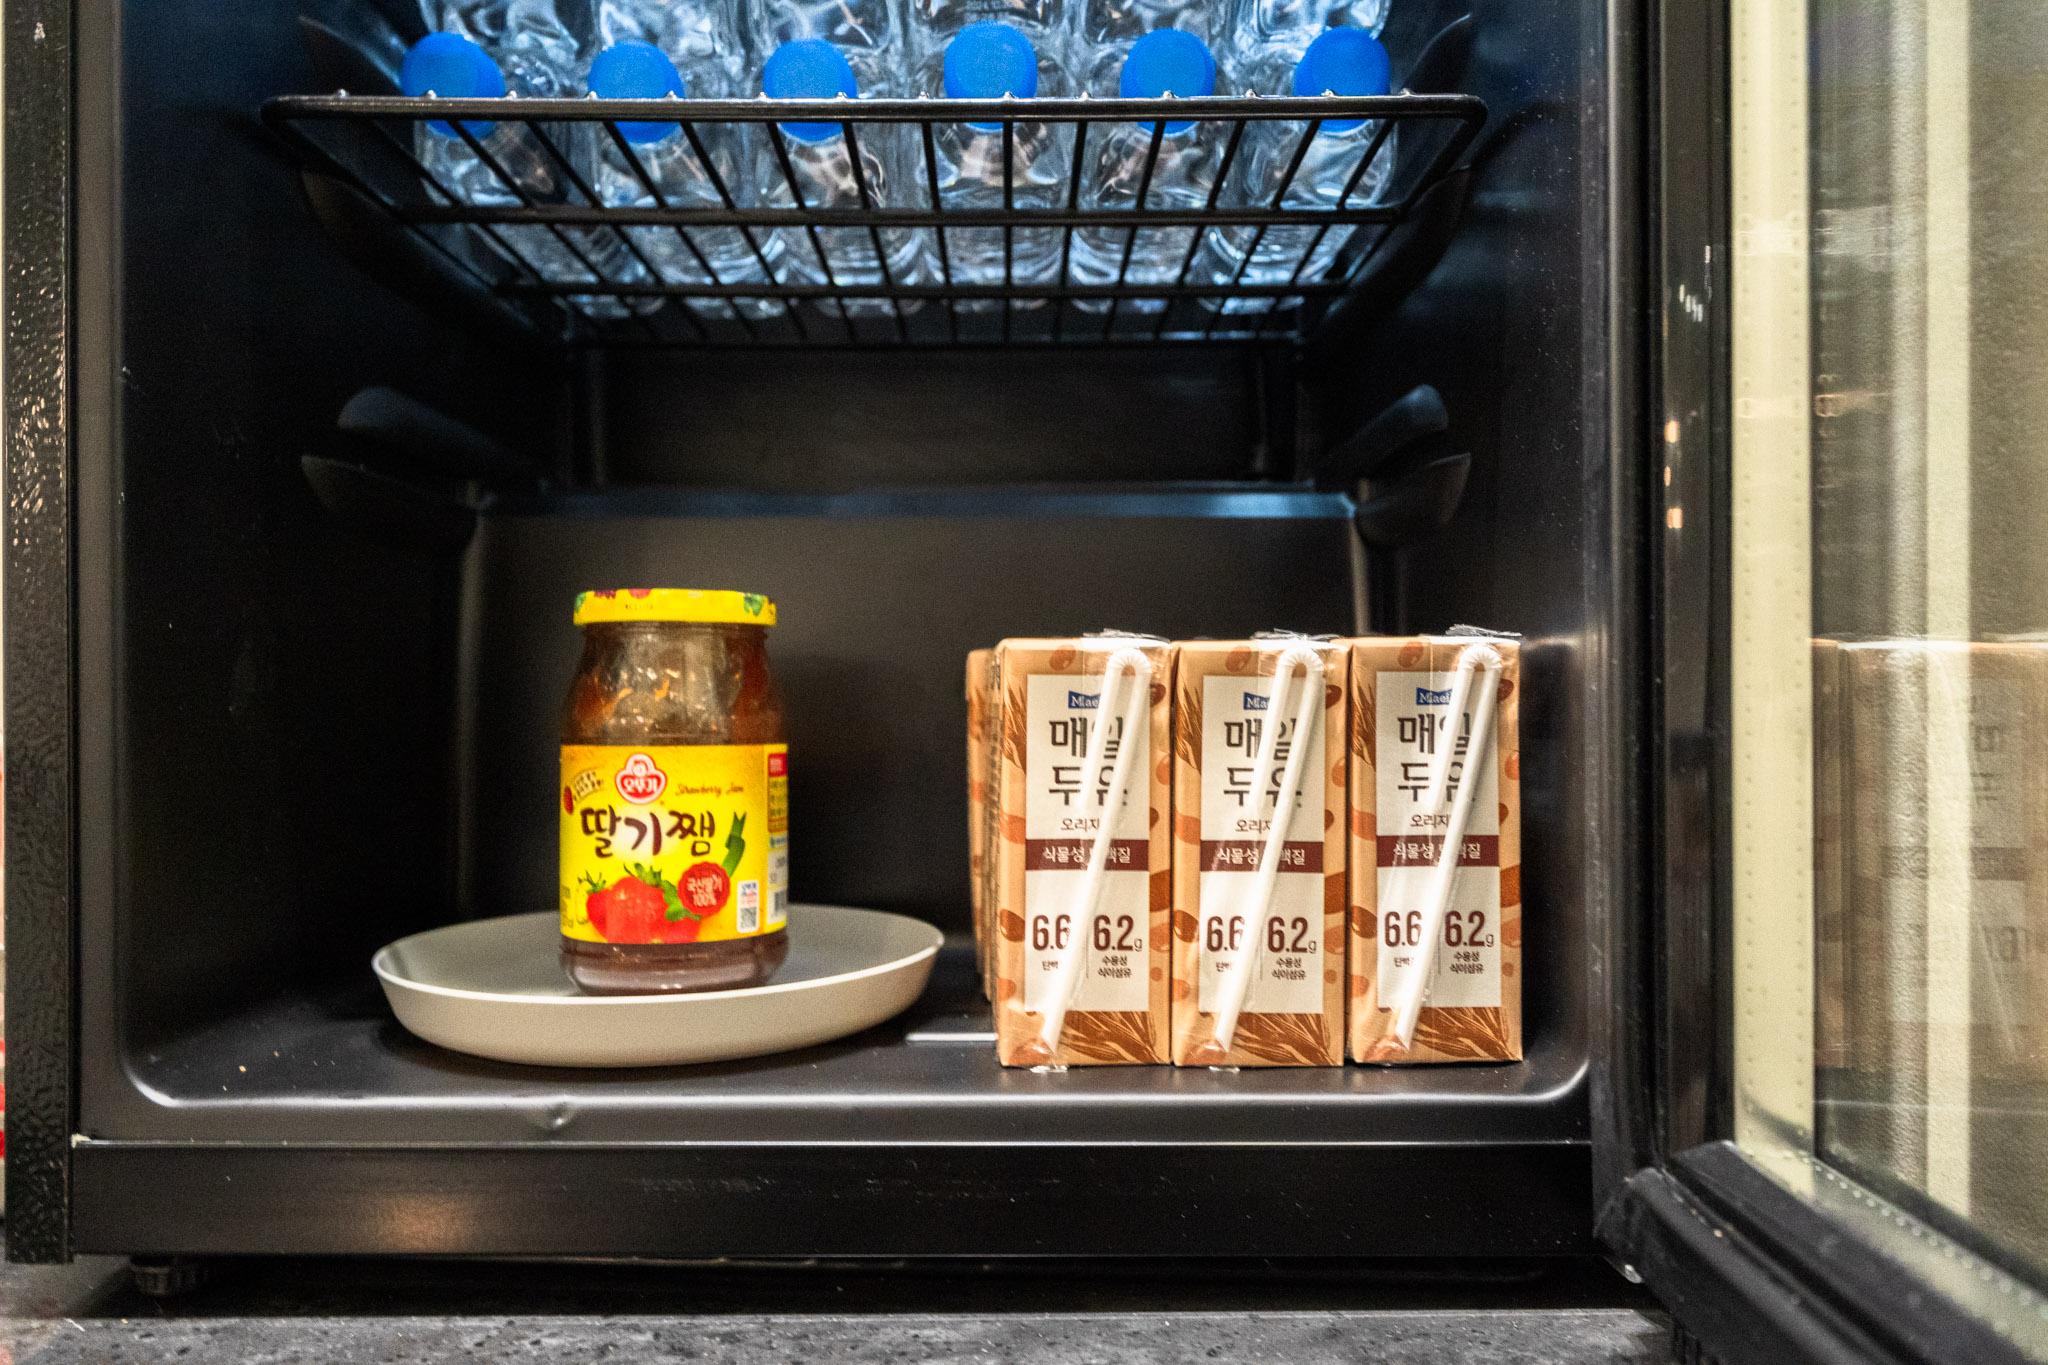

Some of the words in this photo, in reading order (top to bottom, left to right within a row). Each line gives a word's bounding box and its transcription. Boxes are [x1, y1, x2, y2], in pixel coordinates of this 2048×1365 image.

[623, 776, 658, 794] 오뚜기
[1060, 817, 1100, 832] 오리지
[1410, 813, 1450, 829] 오리지
[580, 804, 715, 858] 딸기쨈
